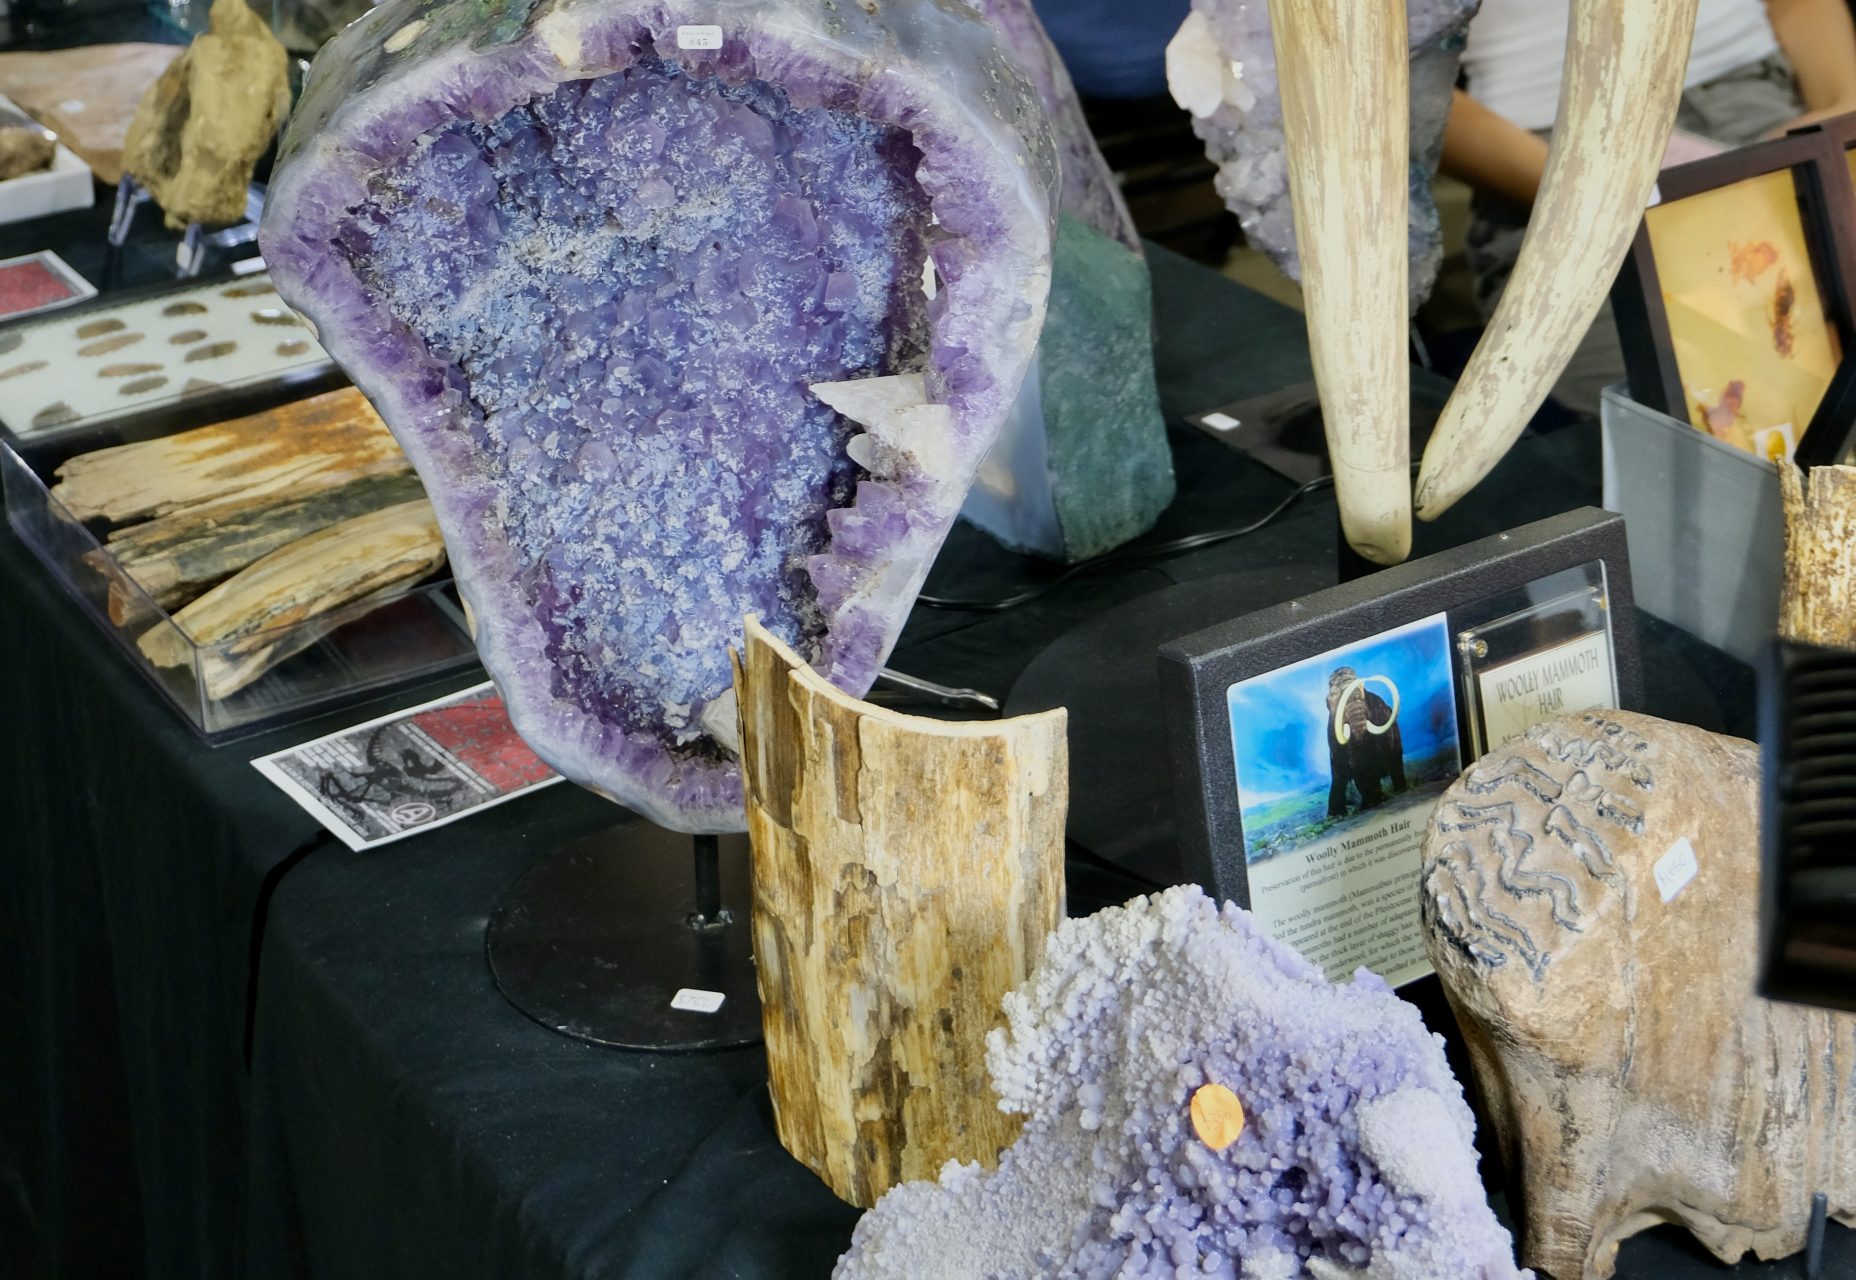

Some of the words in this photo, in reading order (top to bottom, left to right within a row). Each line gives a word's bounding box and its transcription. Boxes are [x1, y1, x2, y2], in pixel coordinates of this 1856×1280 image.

[1542, 648, 1599, 686] MAMMOTH
[1537, 688, 1564, 714] HAIR
[1305, 846, 1337, 866] Woolly
[1340, 828, 1388, 851] Mammoth
[1390, 818, 1411, 833] Hair
[1261, 875, 1300, 894] Preservation
[1301, 870, 1309, 879] of
[1310, 866, 1322, 876] this
[1323, 860, 1335, 871] hair
[1344, 852, 1355, 863] due
[1356, 850, 1363, 859] to
[1364, 846, 1373, 856] the
[1374, 835, 1412, 853] permanently
[1299, 873, 1339, 893] (permafrost)
[1340, 868, 1347, 876] in
[1347, 862, 1366, 874] which
[1373, 854, 1385, 864] was
[1272, 916, 1286, 928] The
[1287, 908, 1311, 924] woolly
[1313, 895, 1347, 913] mammoth
[1347, 879, 1393, 901] (Mammuthus
[1286, 924, 1298, 936] the
[1299, 916, 1321, 931] tundra
[1360, 898, 1374, 908] was
[1380, 887, 1405, 902] species
[1405, 880, 1415, 891] of
[1319, 927, 1326, 936] at
[1327, 922, 1338, 933] the
[1339, 917, 1353, 929] end
[1353, 912, 1362, 923] of
[1362, 909, 1373, 920] the
[1374, 896, 1412, 915] Pleistocene
[1318, 951, 1330, 962] the
[1330, 944, 1348, 957] thick
[1349, 937, 1366, 952] layer
[1367, 932, 1375, 943] of
[1375, 925, 1399, 942] shaggy
[1332, 932, 1346, 944] had
[1352, 921, 1378, 937] number
[1379, 915, 1388, 926] of
[1367, 944, 1378, 956] for
[1379, 937, 1400, 951] which
[1401, 931, 1412, 942] the
[1384, 959, 1409, 976] molted
[1389, 949, 1397, 960] to
[1398, 943, 1416, 956] those
